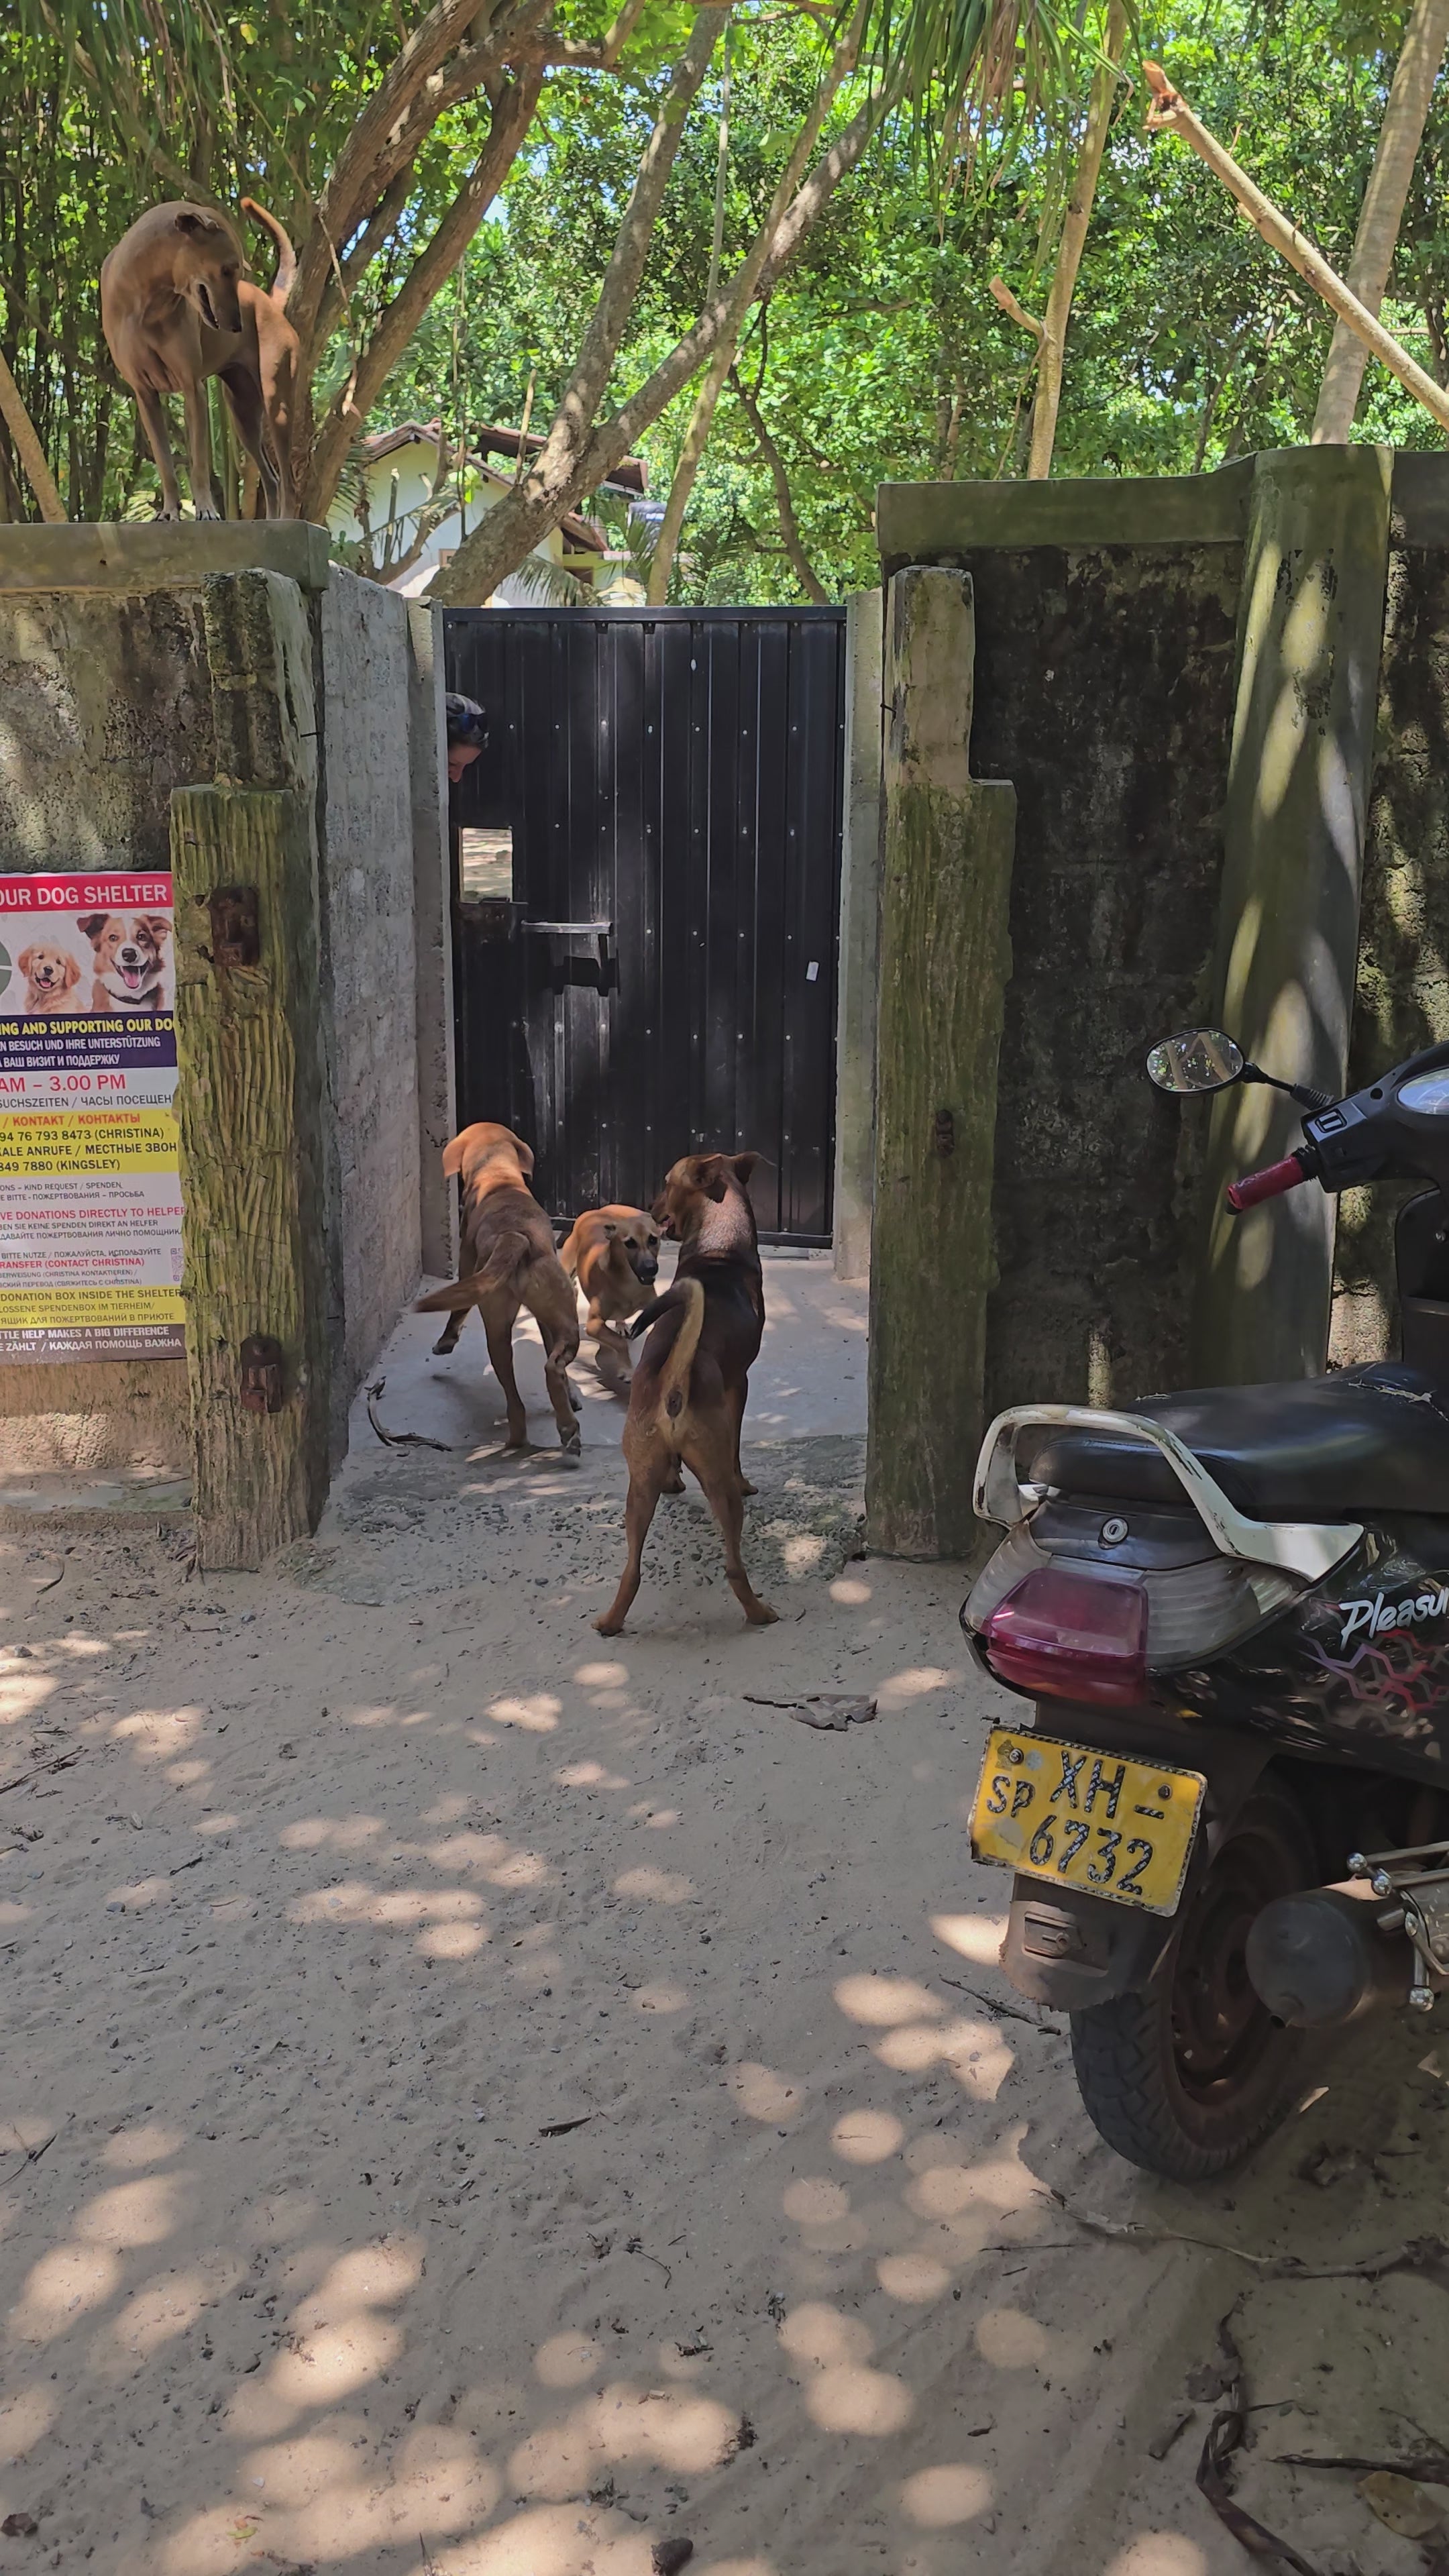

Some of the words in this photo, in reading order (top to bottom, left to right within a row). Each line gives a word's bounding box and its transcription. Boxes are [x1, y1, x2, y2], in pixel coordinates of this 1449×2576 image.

[38, 887, 78, 904] DOG
[84, 884, 167, 903] SHELTER
[21, 1022, 47, 1034] AND
[50, 1020, 123, 1034] SUPPORTING
[126, 1018, 153, 1031] OUR
[155, 1018, 175, 1030] DO
[9, 1040, 43, 1051] BESUCH
[45, 1039, 64, 1050] UND
[66, 1038, 87, 1049] IHRE
[88, 1035, 161, 1049] UNTERSTÜTZUNG
[4, 1056, 24, 1068] ВАШ
[27, 1055, 55, 1067] ВИЗИТ
[57, 1055, 64, 1066] И
[66, 1053, 120, 1067] ПОДДЕРЖКУ
[0, 1077, 25, 1092] AM
[50, 1075, 91, 1091] 3.00
[97, 1074, 126, 1089] PM
[81, 1095, 113, 1106] ЧАСЫ
[13, 1116, 64, 1127] KONTAKT
[78, 1114, 140, 1124] КОНТАКТЫ
[17, 1131, 32, 1141] 76
[36, 1131, 58, 1140] 793
[62, 1130, 91, 1140] 8473
[95, 1128, 164, 1140] (CHRISTINA)
[27, 1145, 72, 1156] ANRUFE
[85, 1143, 142, 1155] МЕСТНЫЕ
[23, 1161, 52, 1171] 7880
[56, 1159, 120, 1172] (KINGSLEY)
[44, 1183, 78, 1191] REQUEST
[33, 1192, 100, 1200] ПОЖЕРТВОВАНИЯ
[15, 1210, 76, 1220] DONATIONS
[79, 1208, 127, 1218] DIRECTLY
[130, 1208, 144, 1217] TO
[28, 1222, 50, 1230] KEINE
[52, 1221, 87, 1229] SPENDEN
[36, 1231, 103, 1239] ПОЖЕРТВОВАНИЯ
[133, 1228, 182, 1237] ПОМОЩНИК
[45, 1259, 89, 1269] (CONTACT
[92, 1258, 145, 1267] CHRISTINA)
[1, 1292, 52, 1301] DONATION
[56, 1291, 75, 1299] BOX
[79, 1291, 113, 1299] INSIDE
[115, 1290, 134, 1298] THE
[39, 1303, 95, 1312] SPENDENBOX
[1, 1317, 28, 1326] ЯЩИК
[30, 1317, 47, 1325] ДЛЯ
[50, 1315, 127, 1324] ПОЖЕРТВОВАНИЙ
[138, 1313, 174, 1321] ПРИЮТЕ
[22, 1330, 45, 1339] HELP
[48, 1329, 81, 1338] MAKES
[85, 1329, 92, 1337] A
[95, 1328, 111, 1336] BIG
[113, 1326, 169, 1336] DIFFERENCE
[50, 1340, 93, 1351] КАЖДАЯ
[95, 1339, 143, 1349] ПОМОЩЬ
[145, 1338, 182, 1348] ВАЖНА
[987, 1776, 1036, 1819] SP
[1030, 1815, 1153, 1896] 6732
